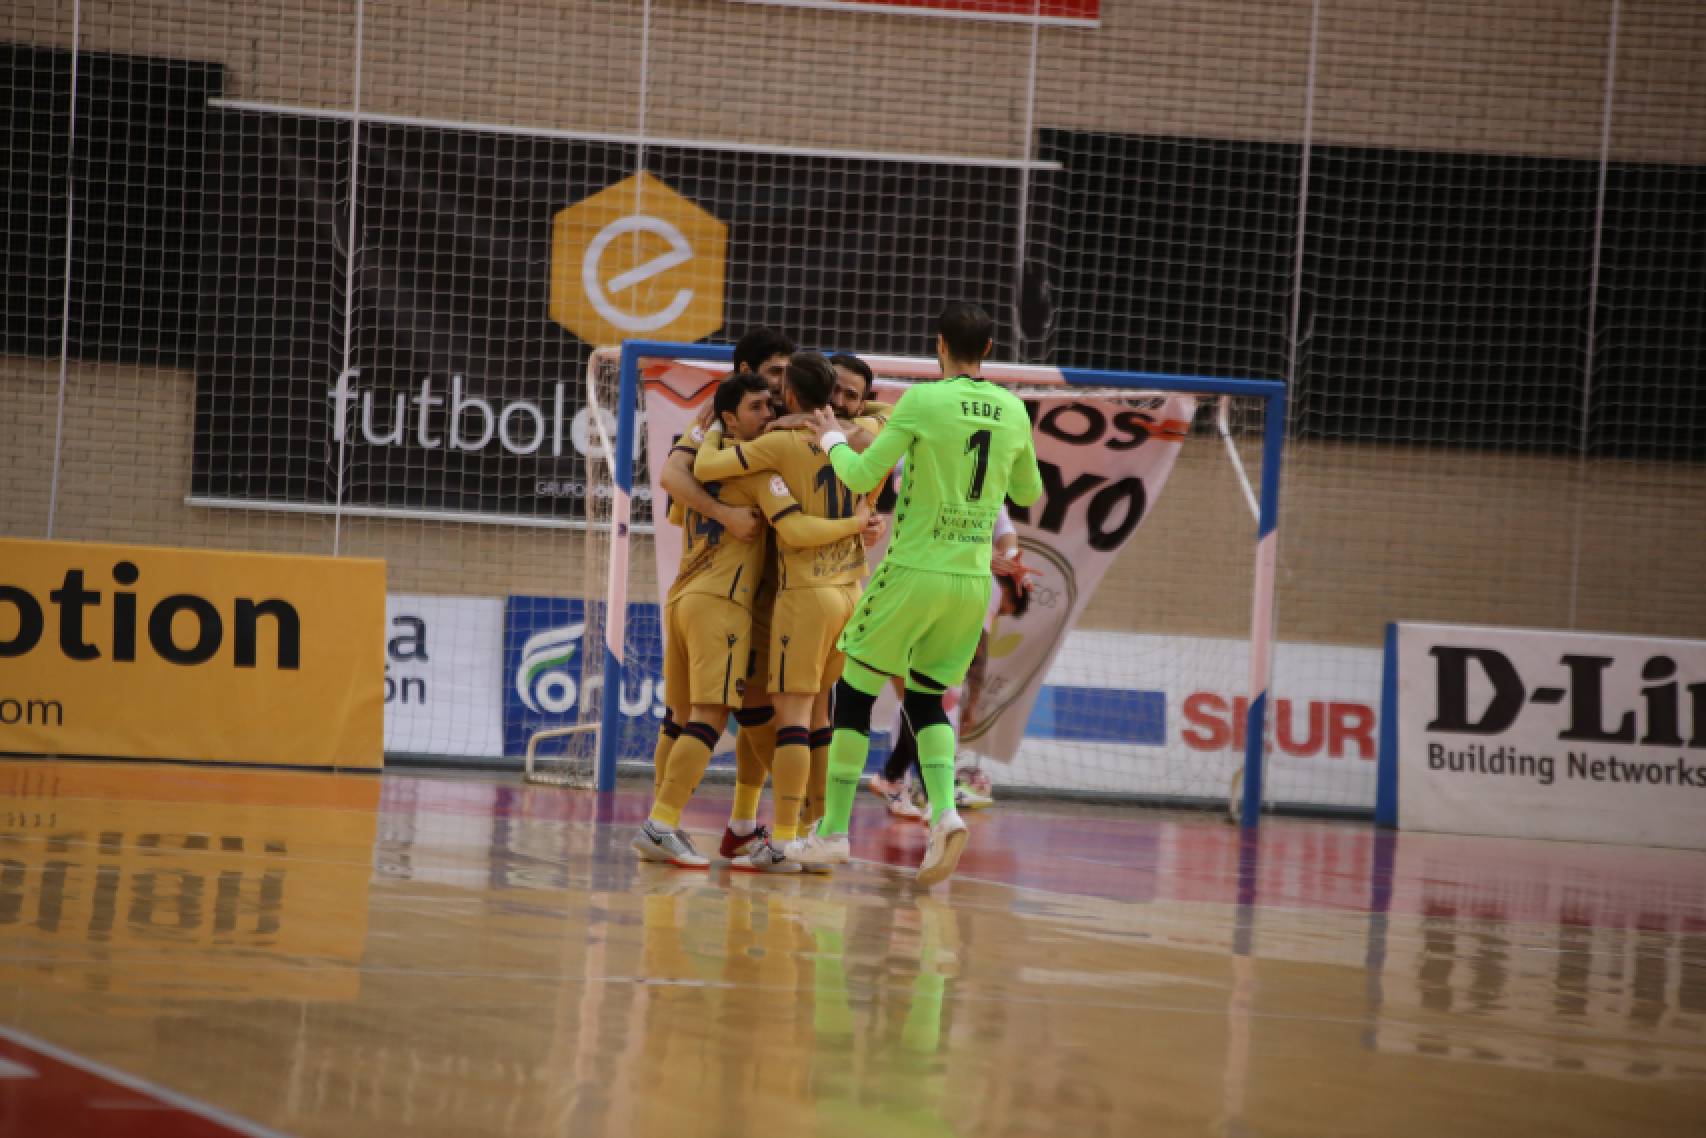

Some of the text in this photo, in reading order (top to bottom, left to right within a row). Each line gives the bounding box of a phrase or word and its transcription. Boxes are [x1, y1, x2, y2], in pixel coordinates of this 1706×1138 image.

[960, 401, 1002, 421] FEDE
[963, 429, 993, 502] 1
[1425, 645, 1706, 749] D-Li
[1427, 742, 1706, 788] Building Networks
